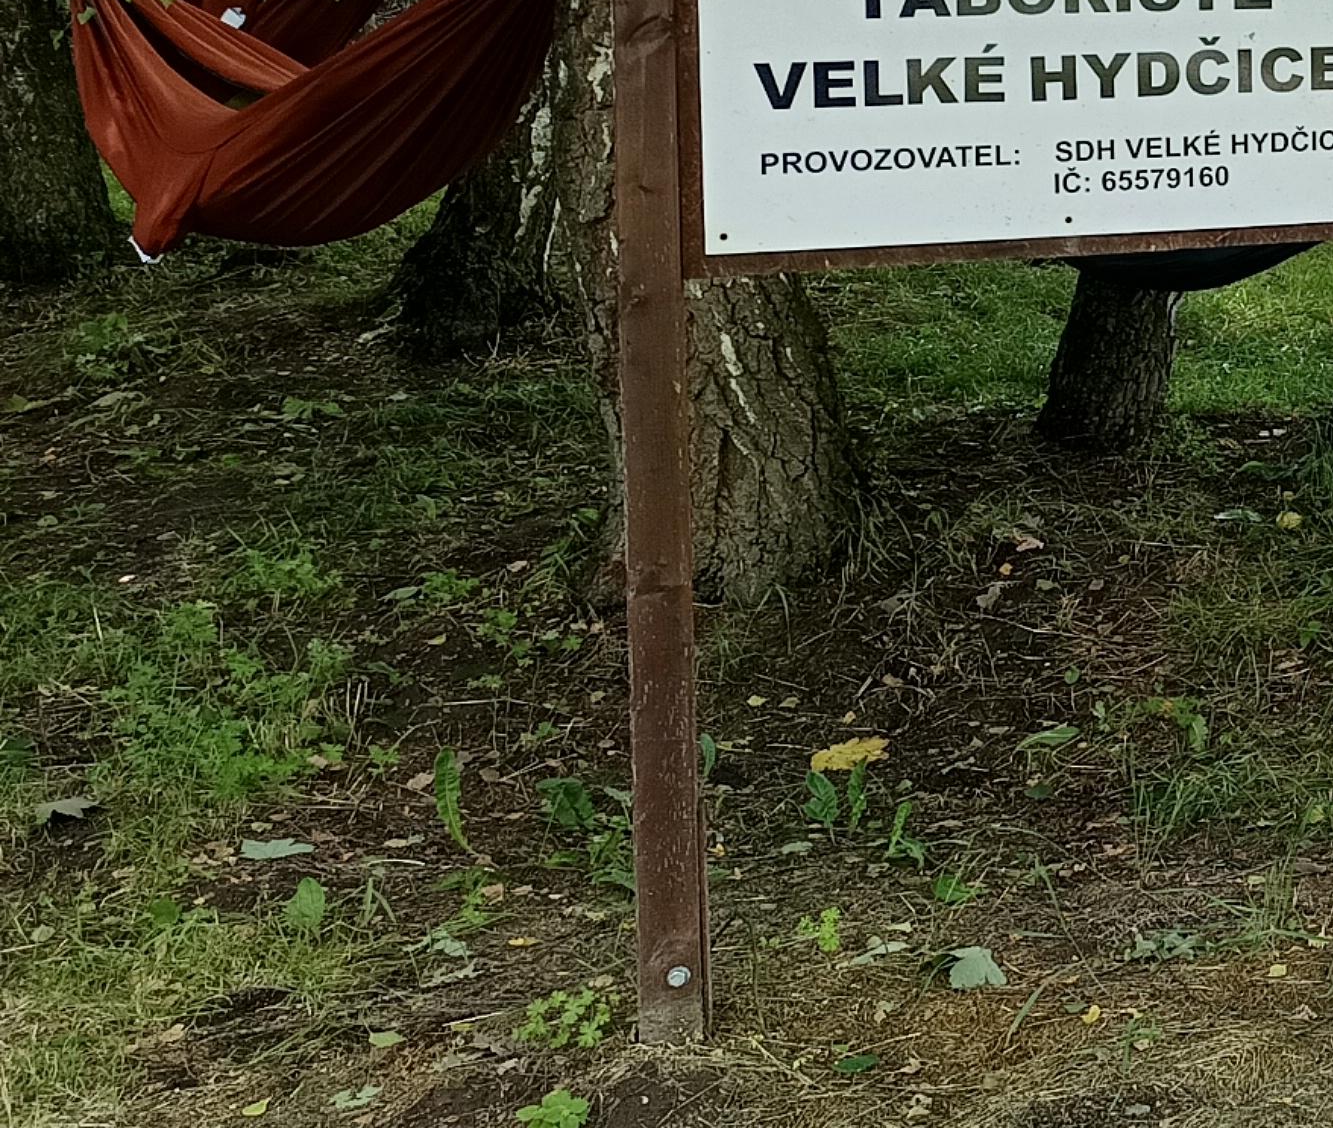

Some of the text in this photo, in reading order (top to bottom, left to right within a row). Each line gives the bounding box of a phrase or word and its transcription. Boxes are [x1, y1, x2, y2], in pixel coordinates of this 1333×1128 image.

[753, 43, 1006, 110] VELKÉ
[760, 144, 1021, 176] PROVOZOVATEL:
[1055, 139, 1115, 163] SDH
[1125, 129, 1221, 159] VELKÉ
[1053, 165, 1229, 194] IČ: 65579160
